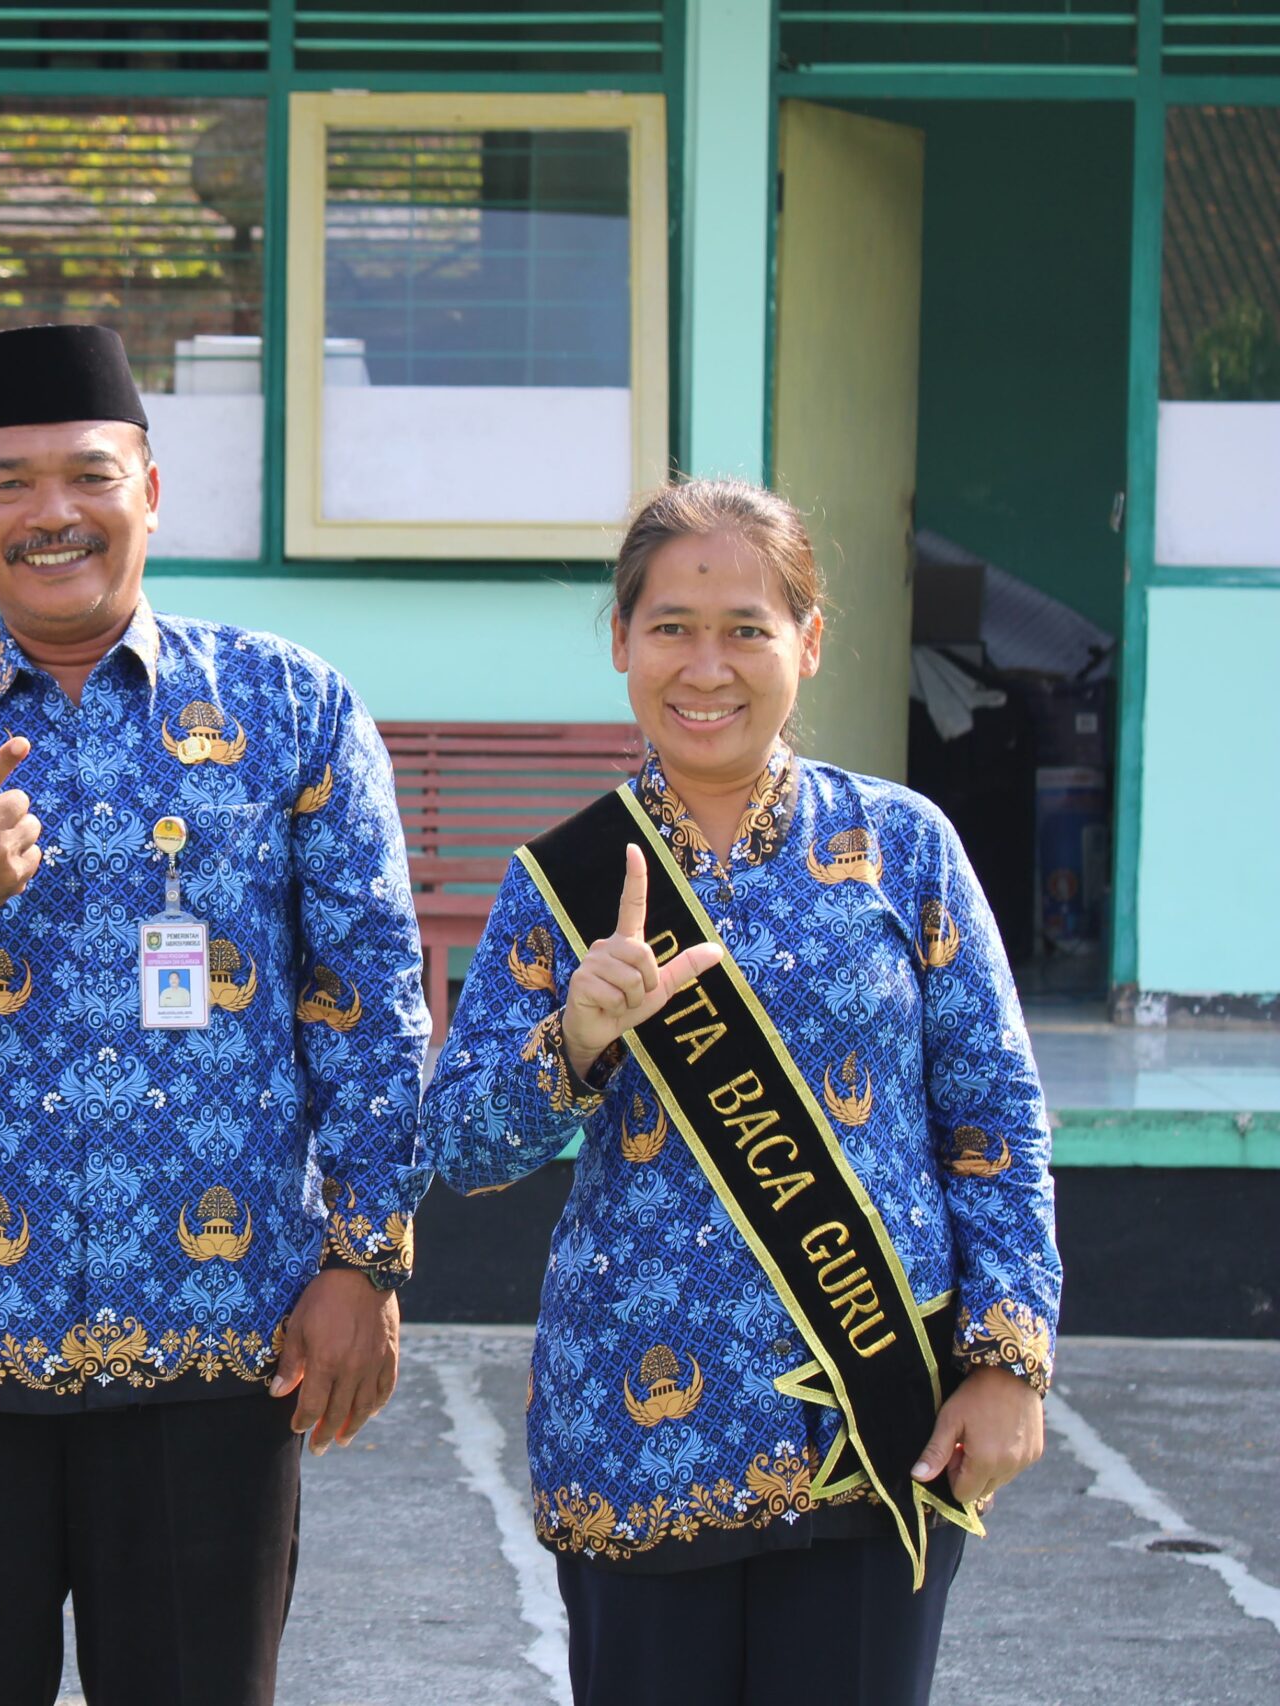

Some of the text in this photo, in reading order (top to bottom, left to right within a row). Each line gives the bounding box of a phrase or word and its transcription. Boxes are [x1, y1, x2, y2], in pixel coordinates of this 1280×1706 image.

[646, 929, 897, 1358] DTA BACA GURU
